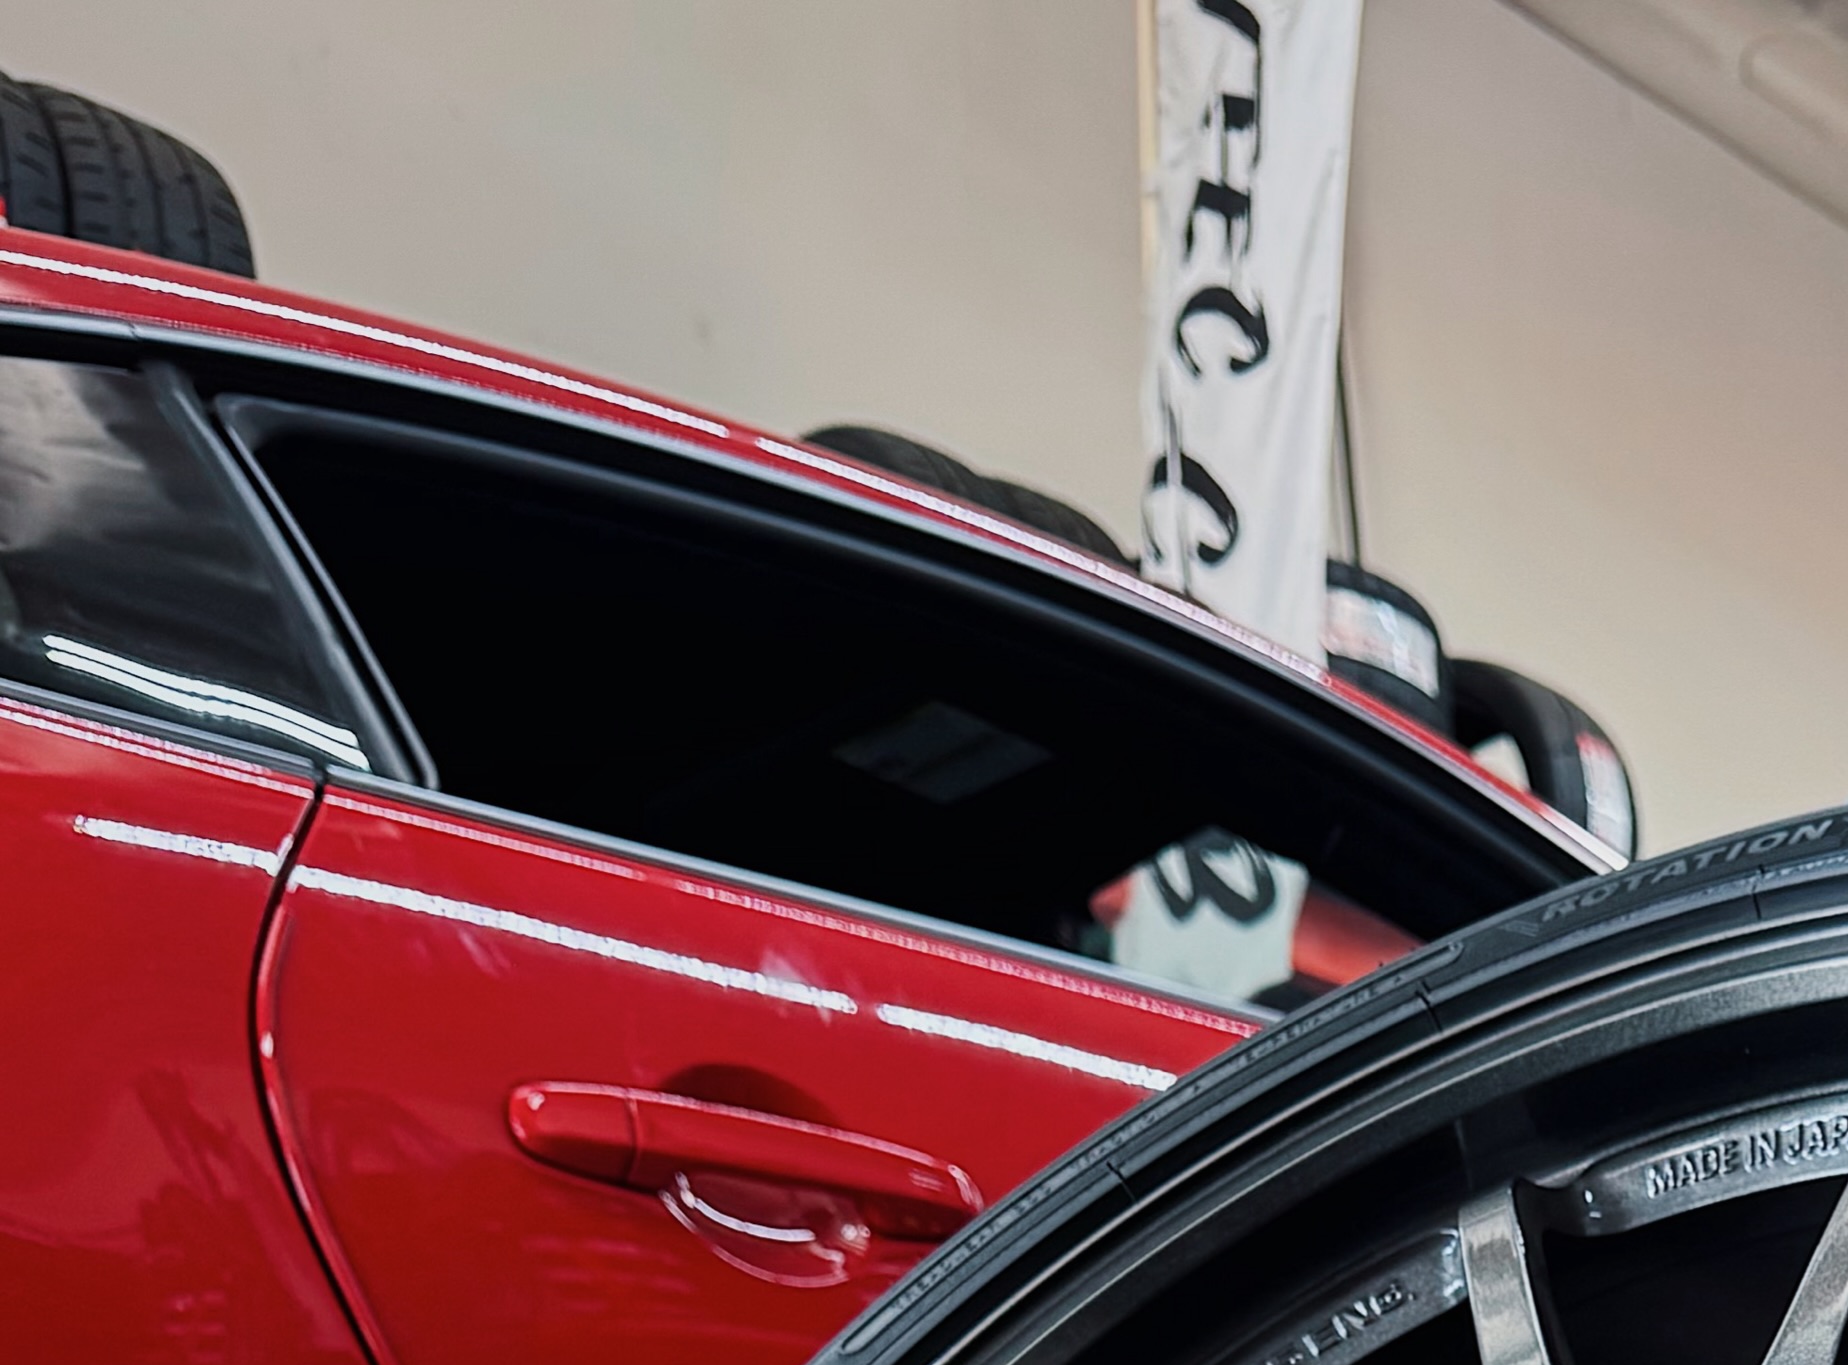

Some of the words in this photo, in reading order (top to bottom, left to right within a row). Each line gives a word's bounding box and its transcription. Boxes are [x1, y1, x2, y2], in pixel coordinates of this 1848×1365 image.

[1541, 820, 1835, 924] ROTATION
[1645, 1139, 1741, 1198] MADE
[1745, 1131, 1778, 1169] IN
